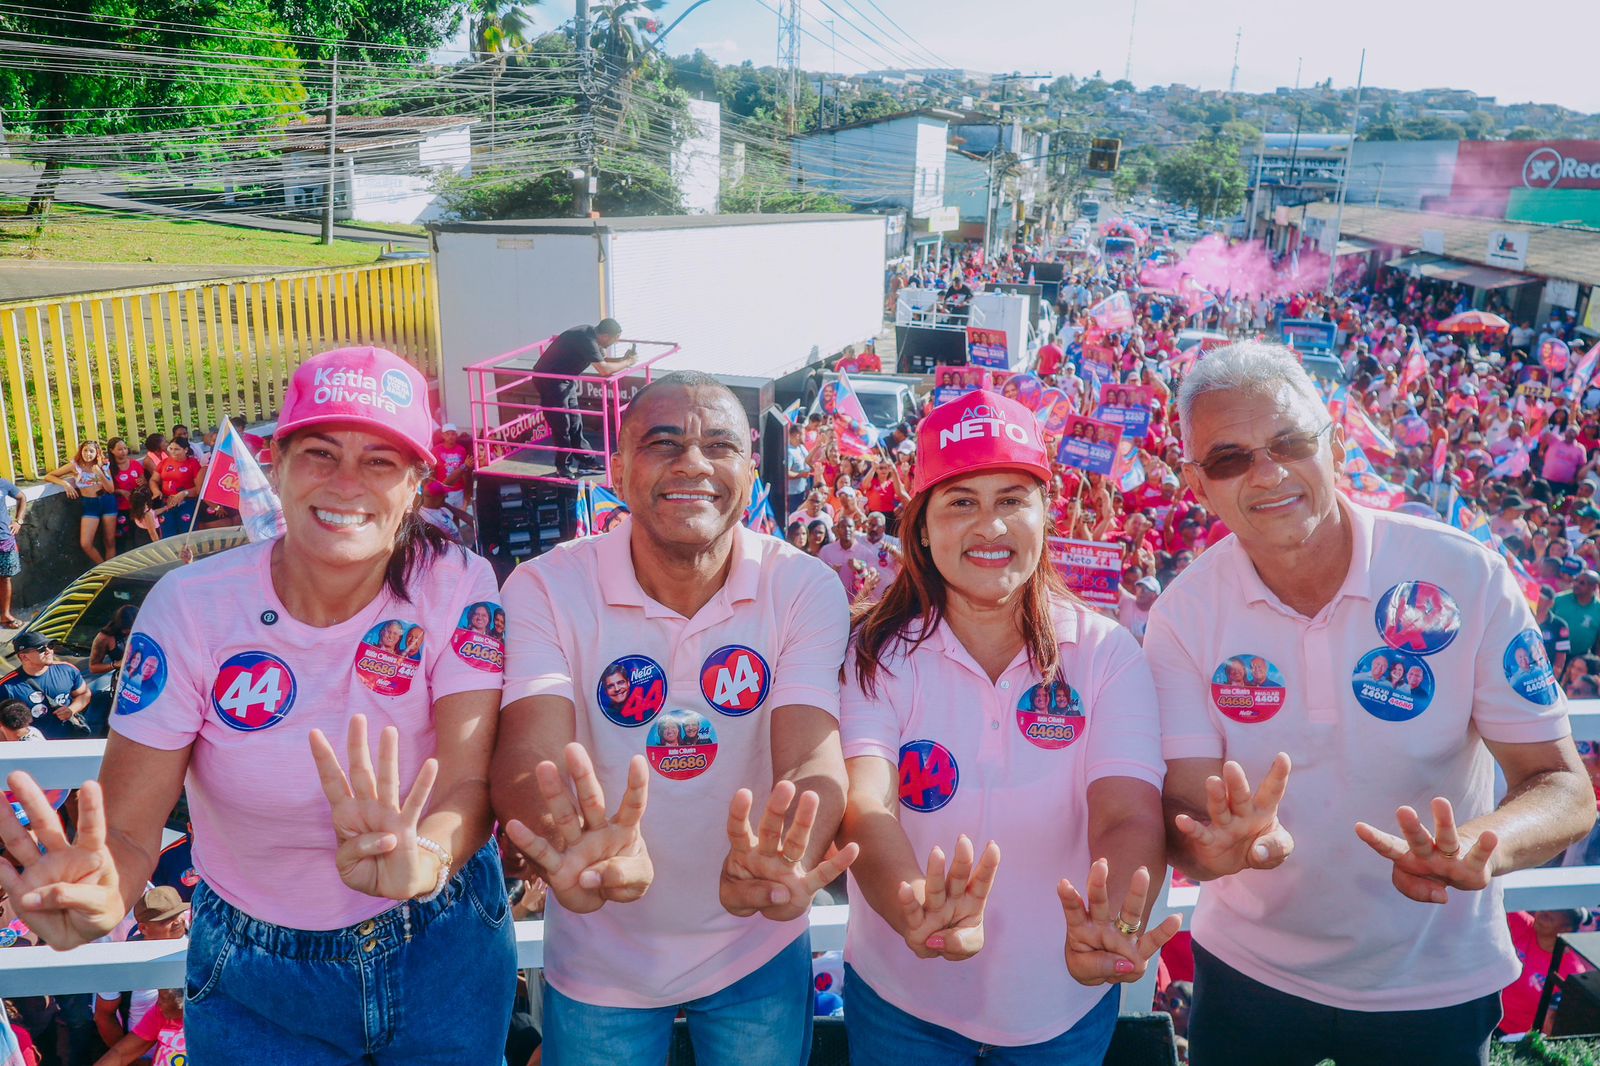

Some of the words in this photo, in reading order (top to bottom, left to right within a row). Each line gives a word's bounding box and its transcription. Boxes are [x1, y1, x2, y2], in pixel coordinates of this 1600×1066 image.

[314, 367, 377, 390] Kátia
[314, 387, 396, 414] Oliveira
[961, 405, 1006, 421] ACM
[940, 417, 1029, 449] NETO
[460, 641, 504, 668] 44686
[359, 657, 397, 677] 44686
[631, 665, 655, 681] Neto
[713, 654, 760, 706] 44
[219, 667, 282, 718] 44
[621, 679, 664, 720] 44
[1218, 695, 1254, 708] 44686
[1255, 695, 1280, 703] 4400
[1361, 688, 1388, 701] 4400
[1026, 722, 1075, 742] 44686
[659, 753, 707, 772] 44686
[898, 745, 955, 807] 44
